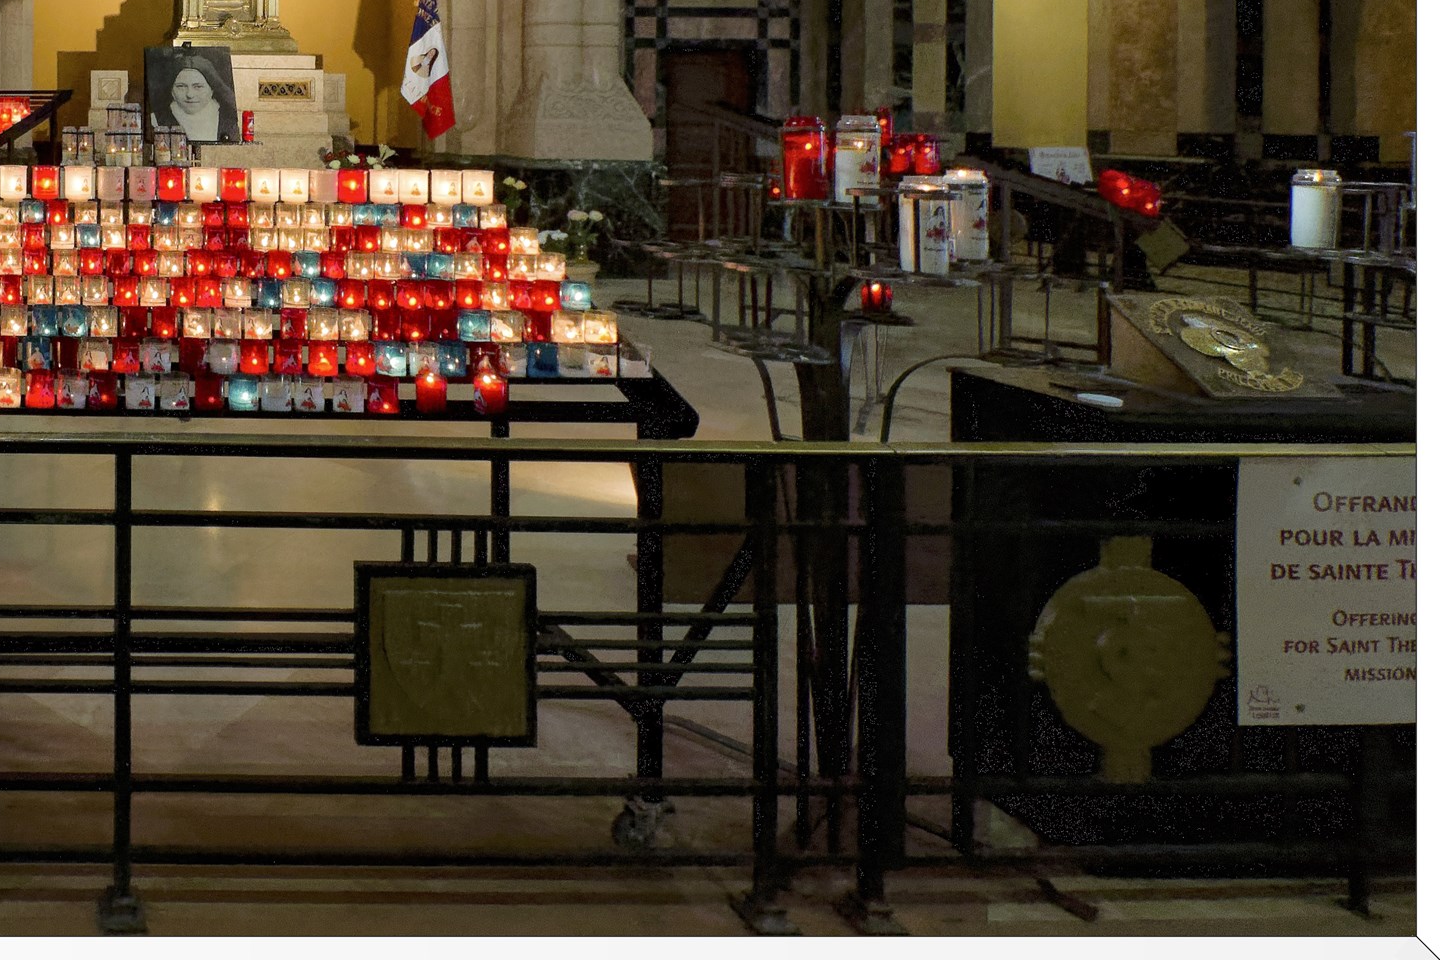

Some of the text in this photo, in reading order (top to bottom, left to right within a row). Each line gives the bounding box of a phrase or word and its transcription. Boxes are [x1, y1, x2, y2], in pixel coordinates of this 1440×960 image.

[1280, 529, 1344, 547] POUR
[1353, 529, 1381, 547] LA
[1271, 563, 1300, 581] DE
[1308, 563, 1389, 581] SAINTE
[1283, 640, 1320, 655] FOR
[1327, 638, 1380, 655] SAINT
[1344, 667, 1416, 683] MISSION
